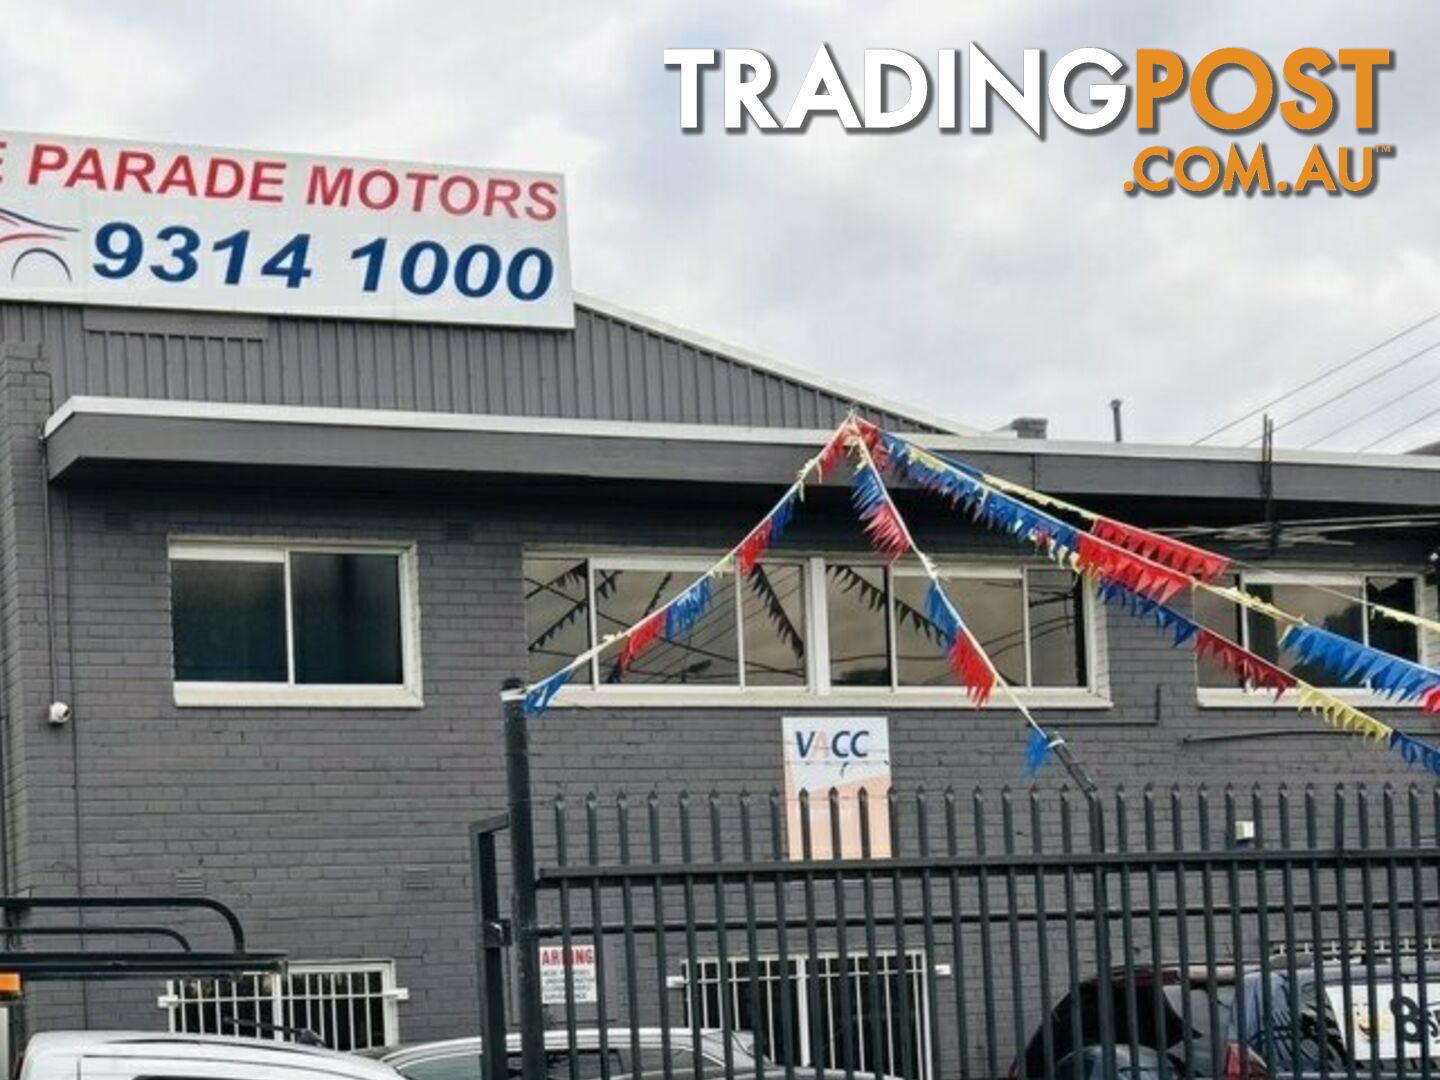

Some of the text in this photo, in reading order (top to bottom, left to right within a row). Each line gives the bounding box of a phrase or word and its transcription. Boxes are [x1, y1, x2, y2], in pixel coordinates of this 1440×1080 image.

[27, 143, 287, 204] PARADE
[305, 163, 560, 222] MOTORS
[93, 220, 554, 302] 9314 1000
[795, 730, 870, 759] VACC
